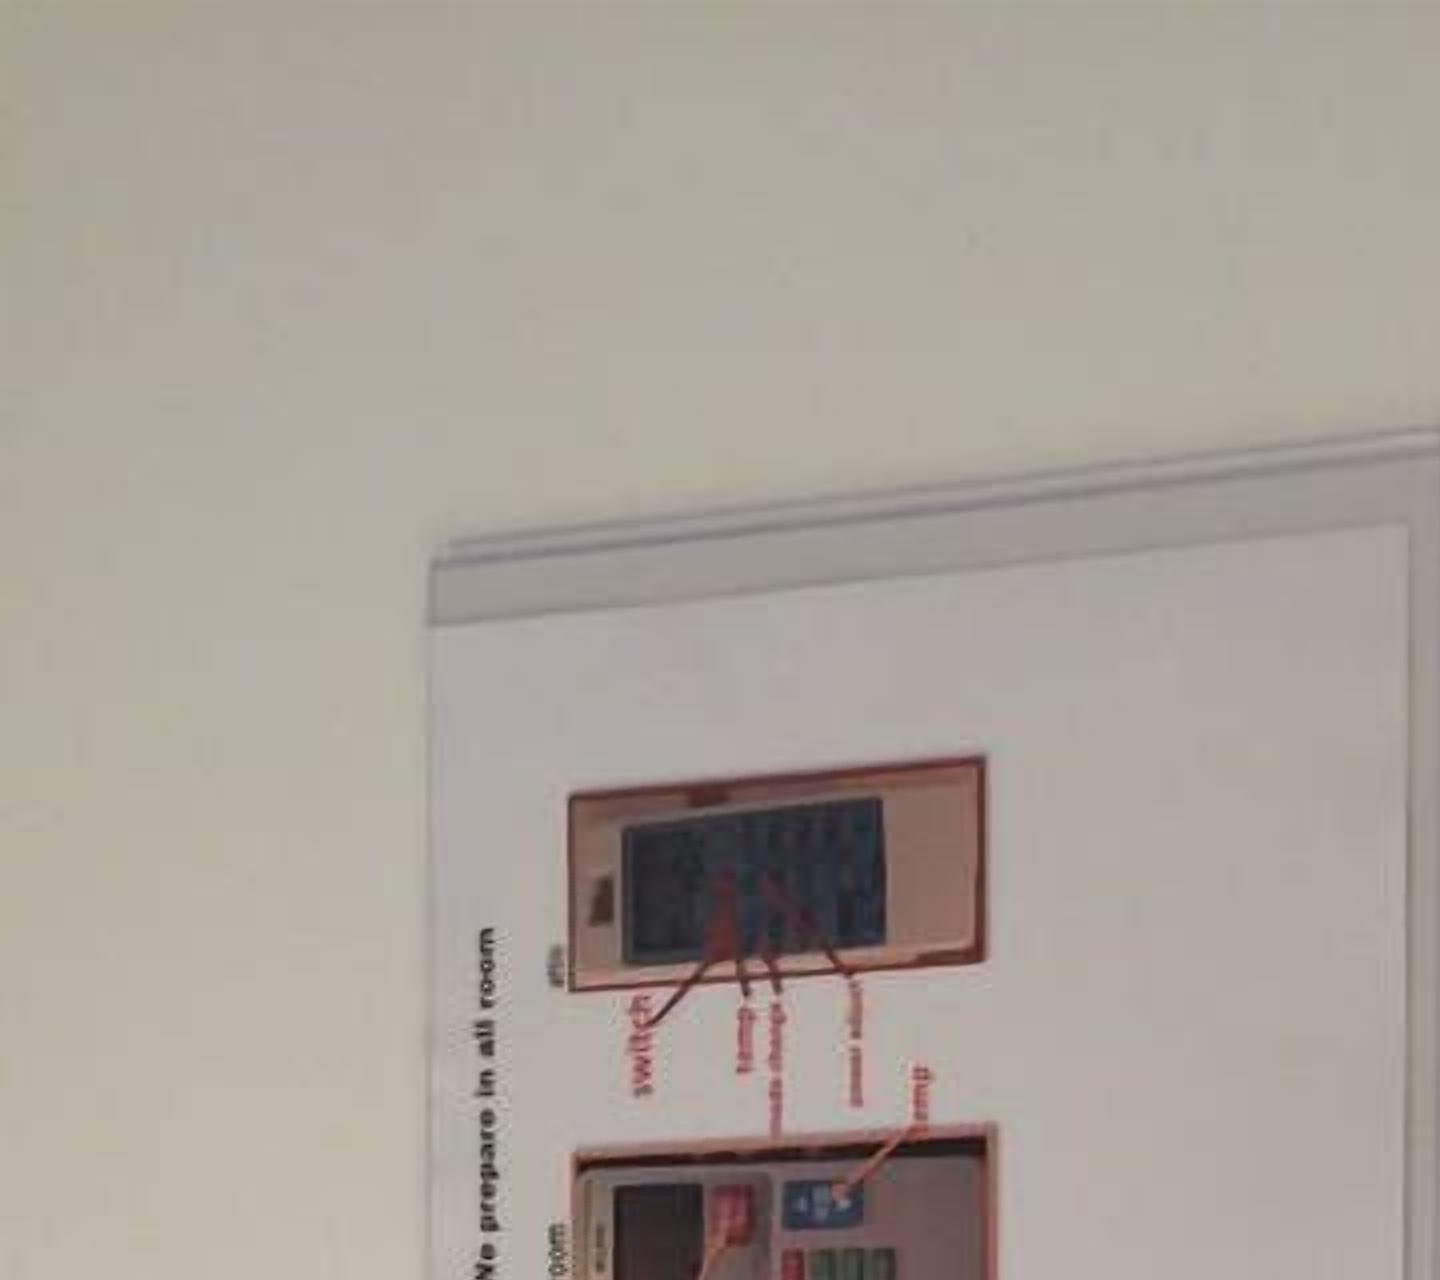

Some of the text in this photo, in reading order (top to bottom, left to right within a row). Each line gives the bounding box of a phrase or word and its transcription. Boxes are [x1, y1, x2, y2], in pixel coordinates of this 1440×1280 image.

[478, 928, 497, 1011] room
[471, 1020, 495, 1058] all
[623, 996, 655, 1100] switch
[735, 1006, 757, 1075] temp
[471, 1069, 495, 1099] in
[478, 1107, 501, 1233] prepare
